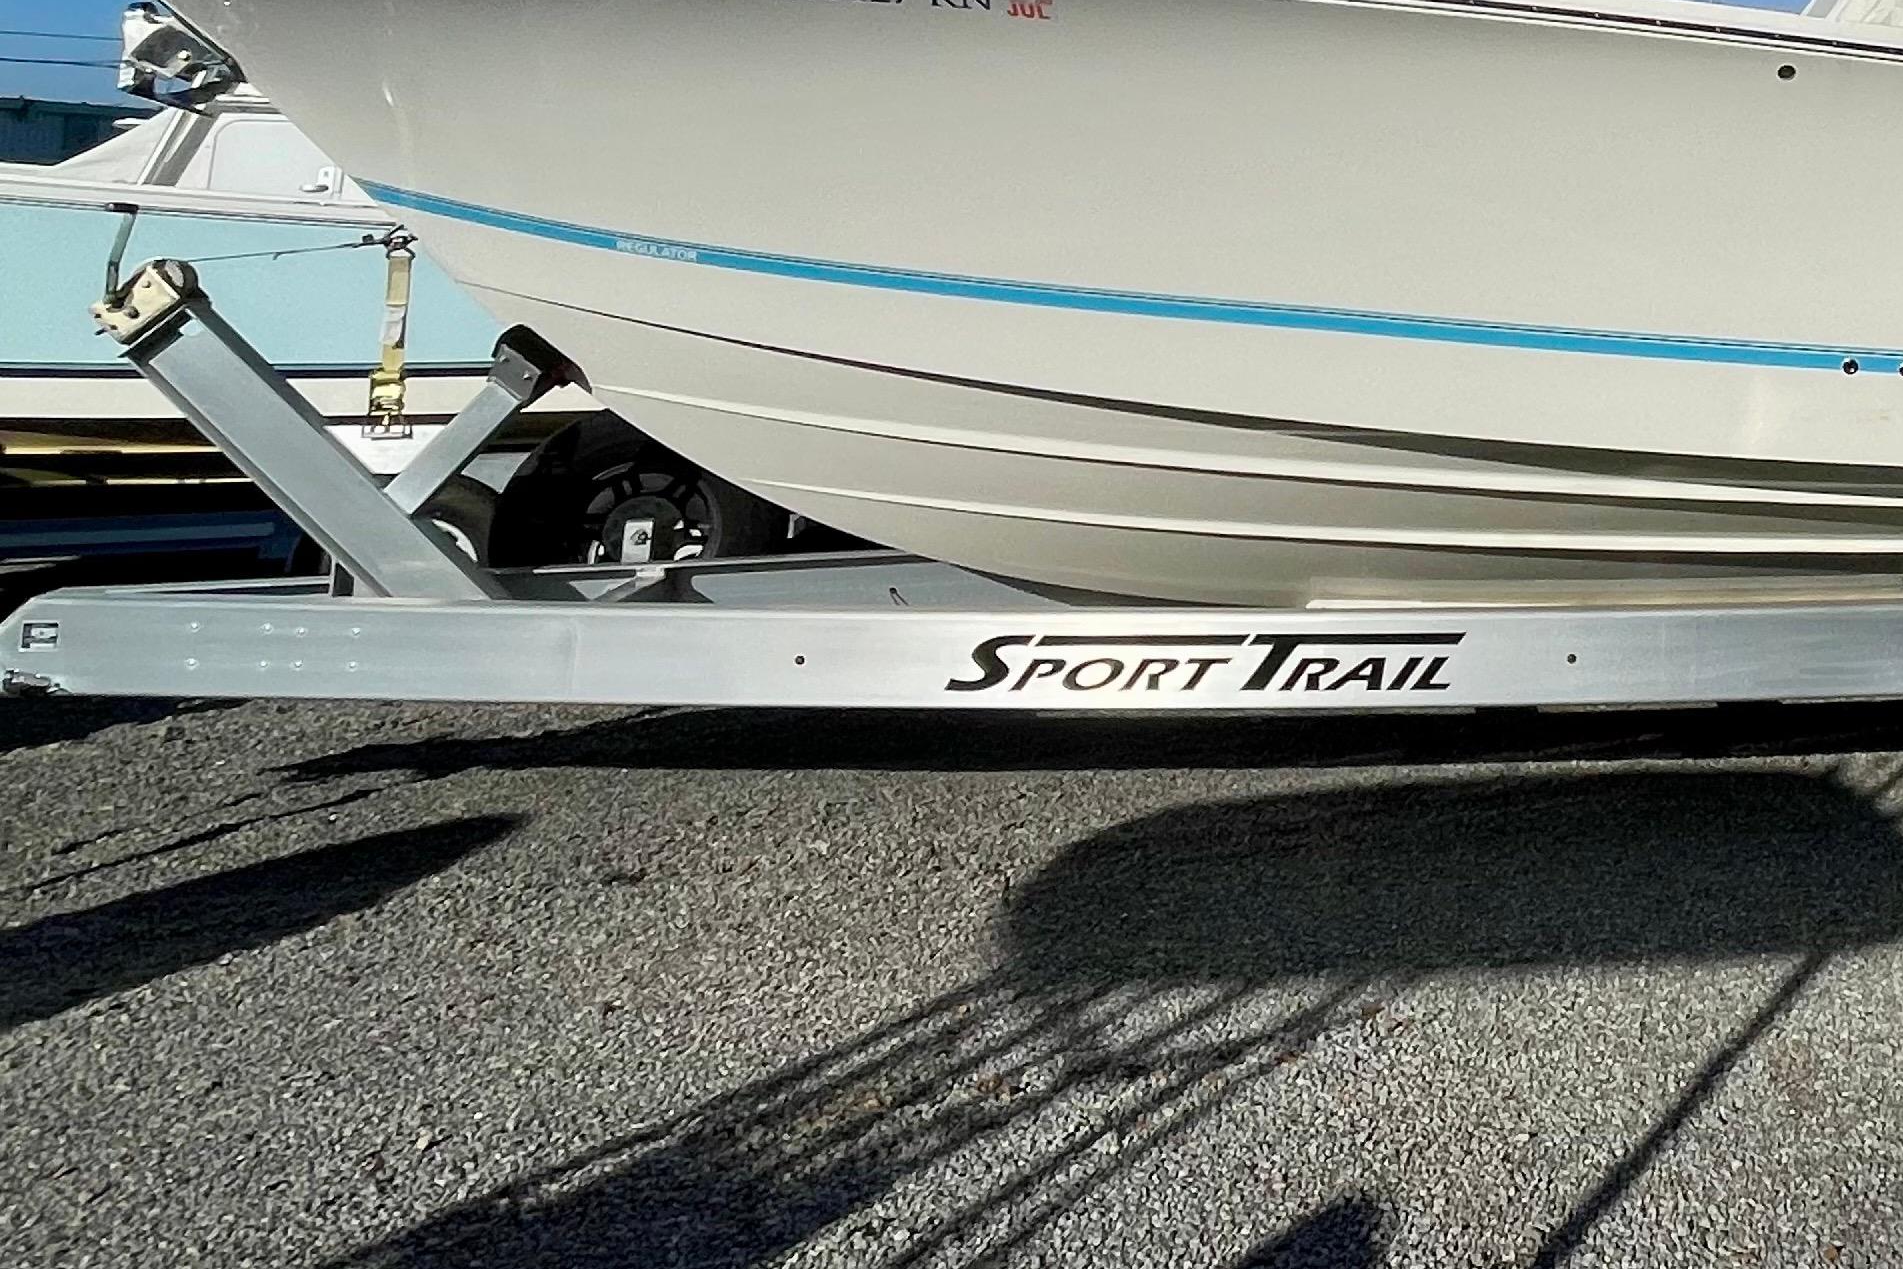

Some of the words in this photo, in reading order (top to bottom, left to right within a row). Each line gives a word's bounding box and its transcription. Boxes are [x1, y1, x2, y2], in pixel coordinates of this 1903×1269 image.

[615, 239, 699, 263] REGULATOR
[944, 634, 1248, 692] SPORT
[1239, 632, 1466, 692] TRAIL
